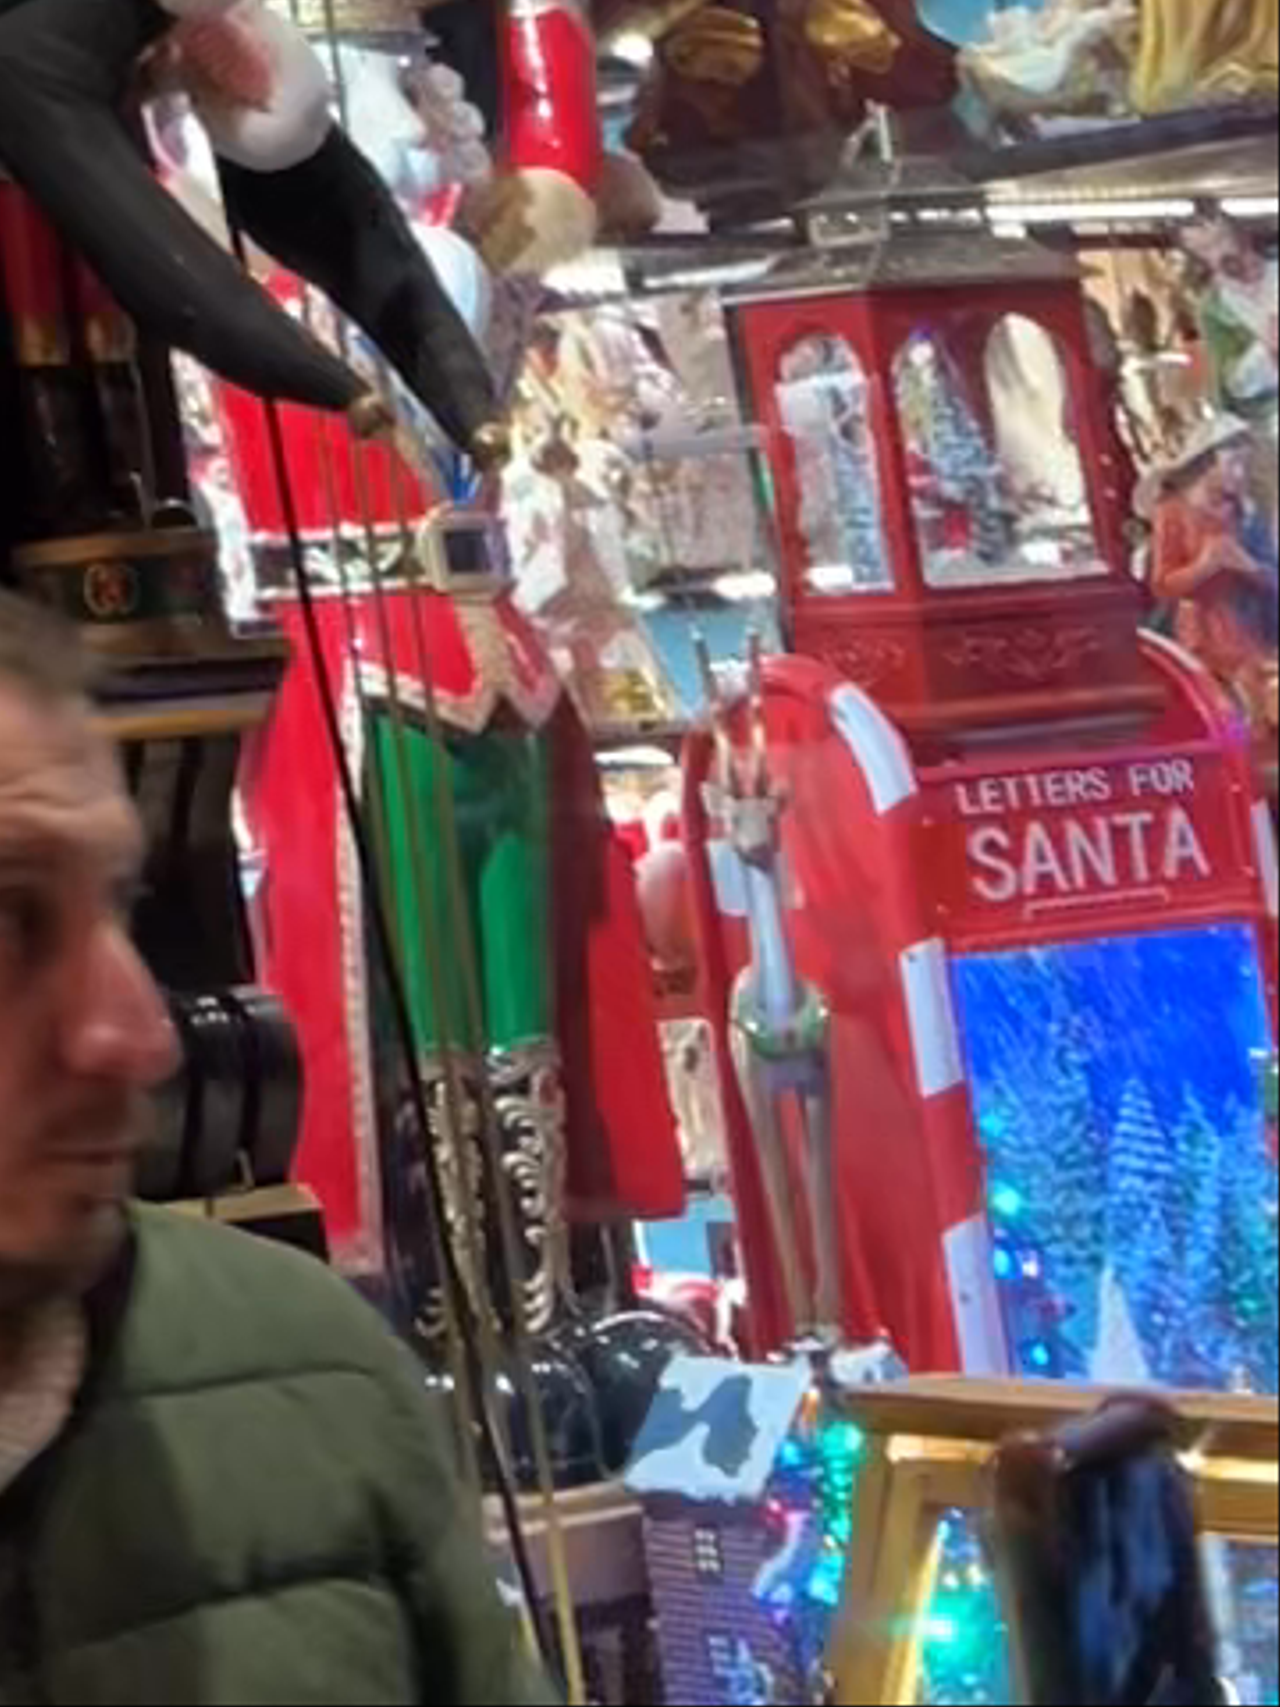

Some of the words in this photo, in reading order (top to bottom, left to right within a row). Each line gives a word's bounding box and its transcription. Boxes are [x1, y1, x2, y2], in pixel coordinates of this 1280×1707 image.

[956, 765, 1111, 817] LETTERS
[1128, 758, 1195, 794] FOR
[970, 806, 1210, 901] SANTA
